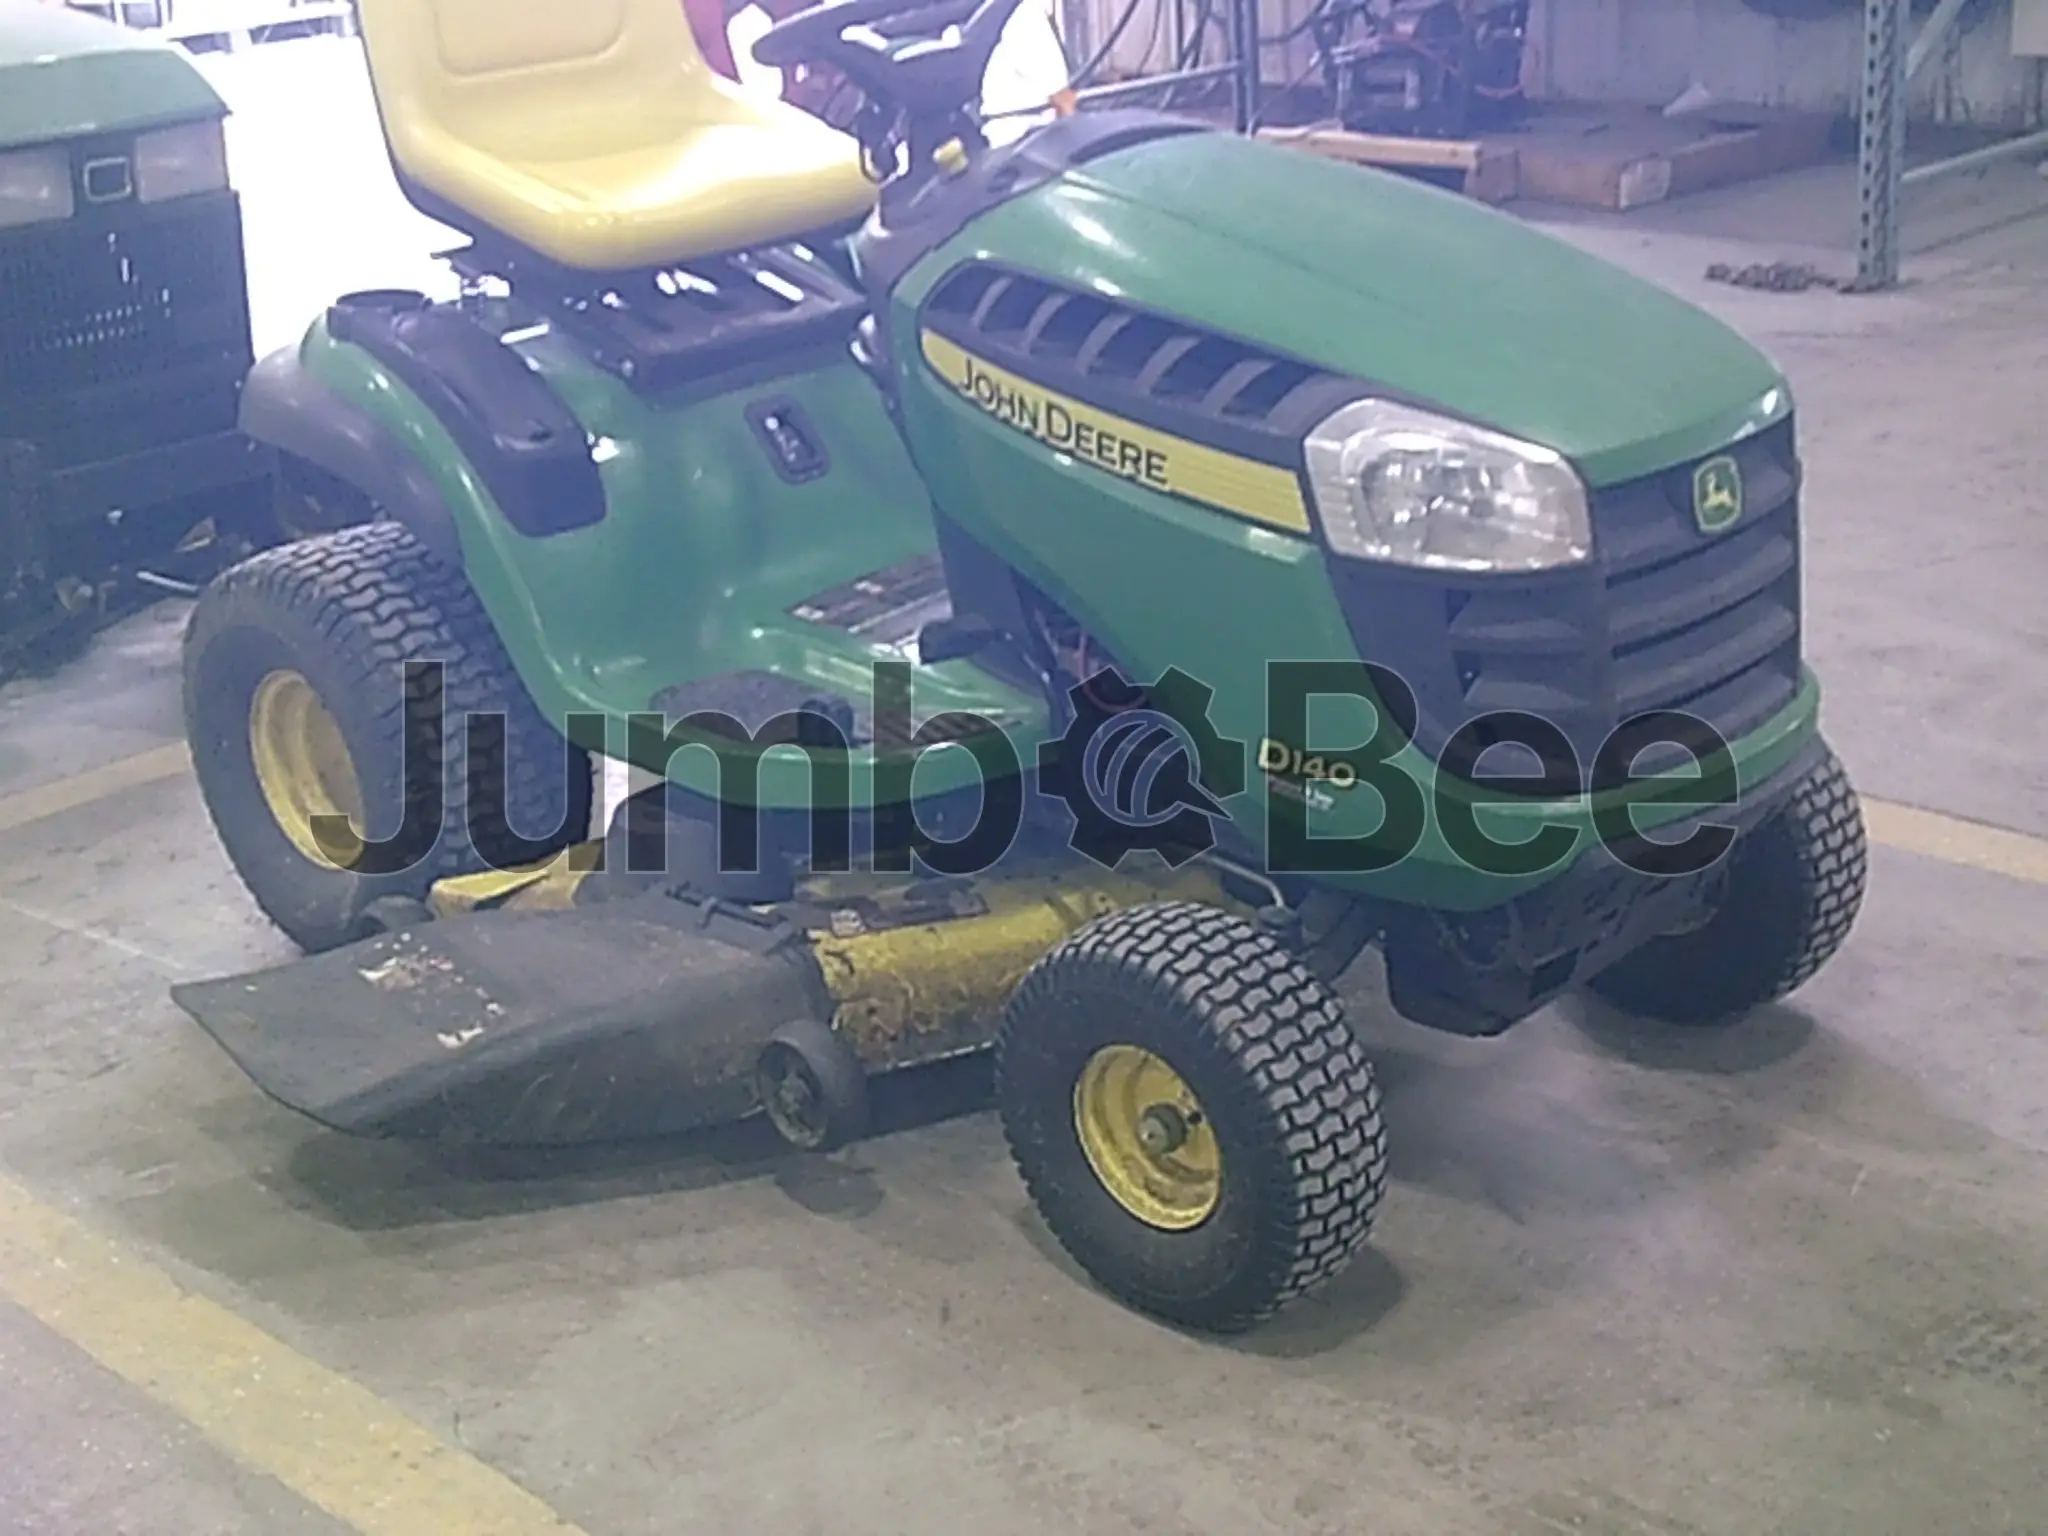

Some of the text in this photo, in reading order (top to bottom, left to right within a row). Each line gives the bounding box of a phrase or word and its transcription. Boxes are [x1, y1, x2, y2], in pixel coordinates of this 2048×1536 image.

[962, 358, 1169, 485] JOHN DEERE
[1258, 738, 1356, 787] D140
